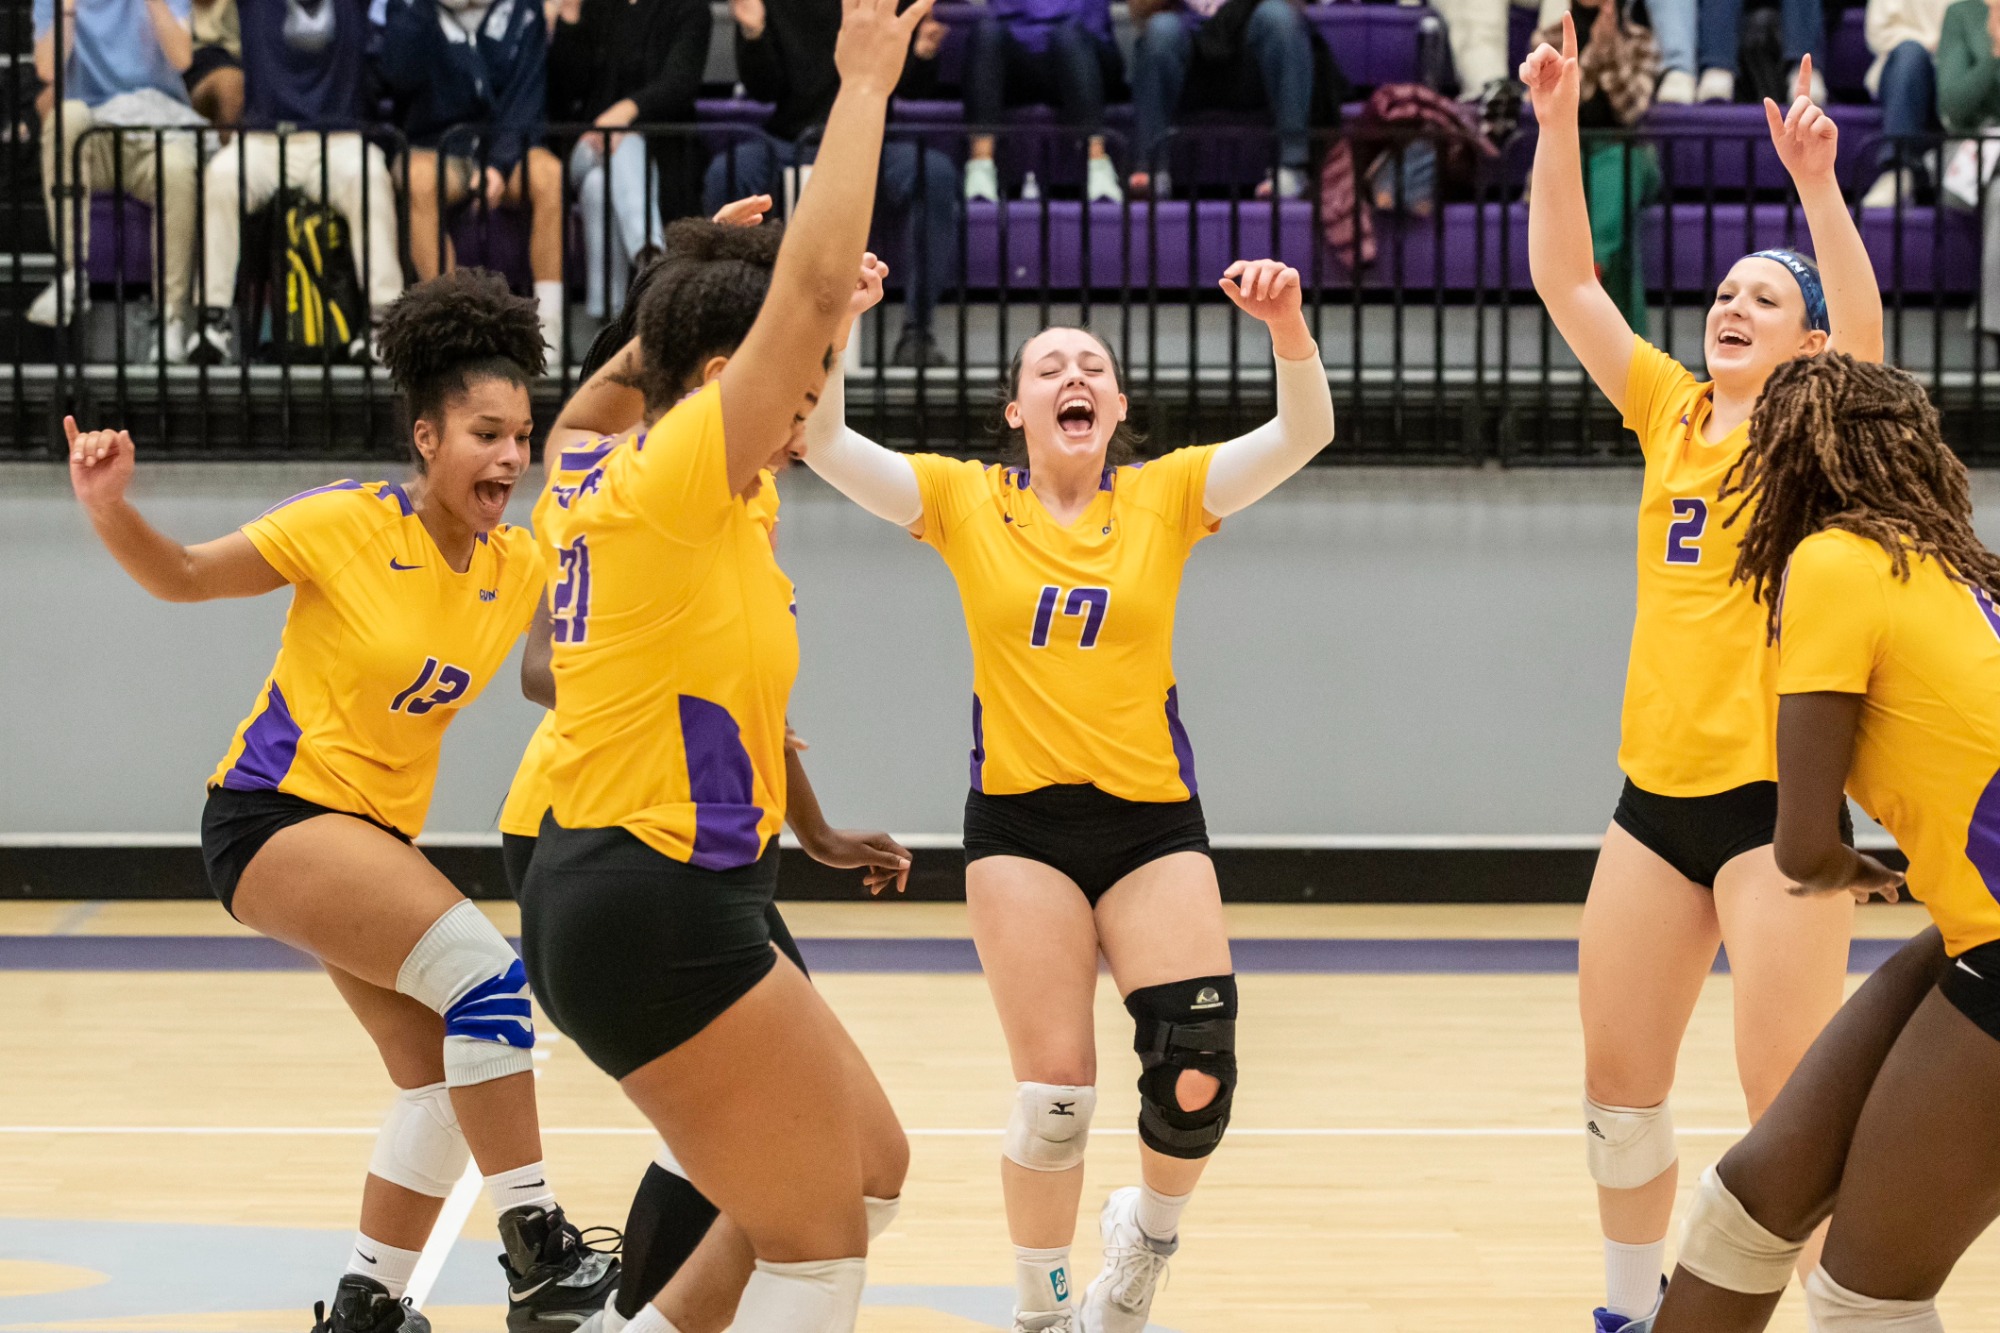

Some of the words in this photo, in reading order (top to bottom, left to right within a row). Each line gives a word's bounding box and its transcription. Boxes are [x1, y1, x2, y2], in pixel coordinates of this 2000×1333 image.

[1665, 498, 1708, 565] 2
[479, 588, 498, 602] CUN
[554, 533, 592, 643] 21
[1030, 585, 1110, 649] 17
[389, 656, 471, 716] 13
